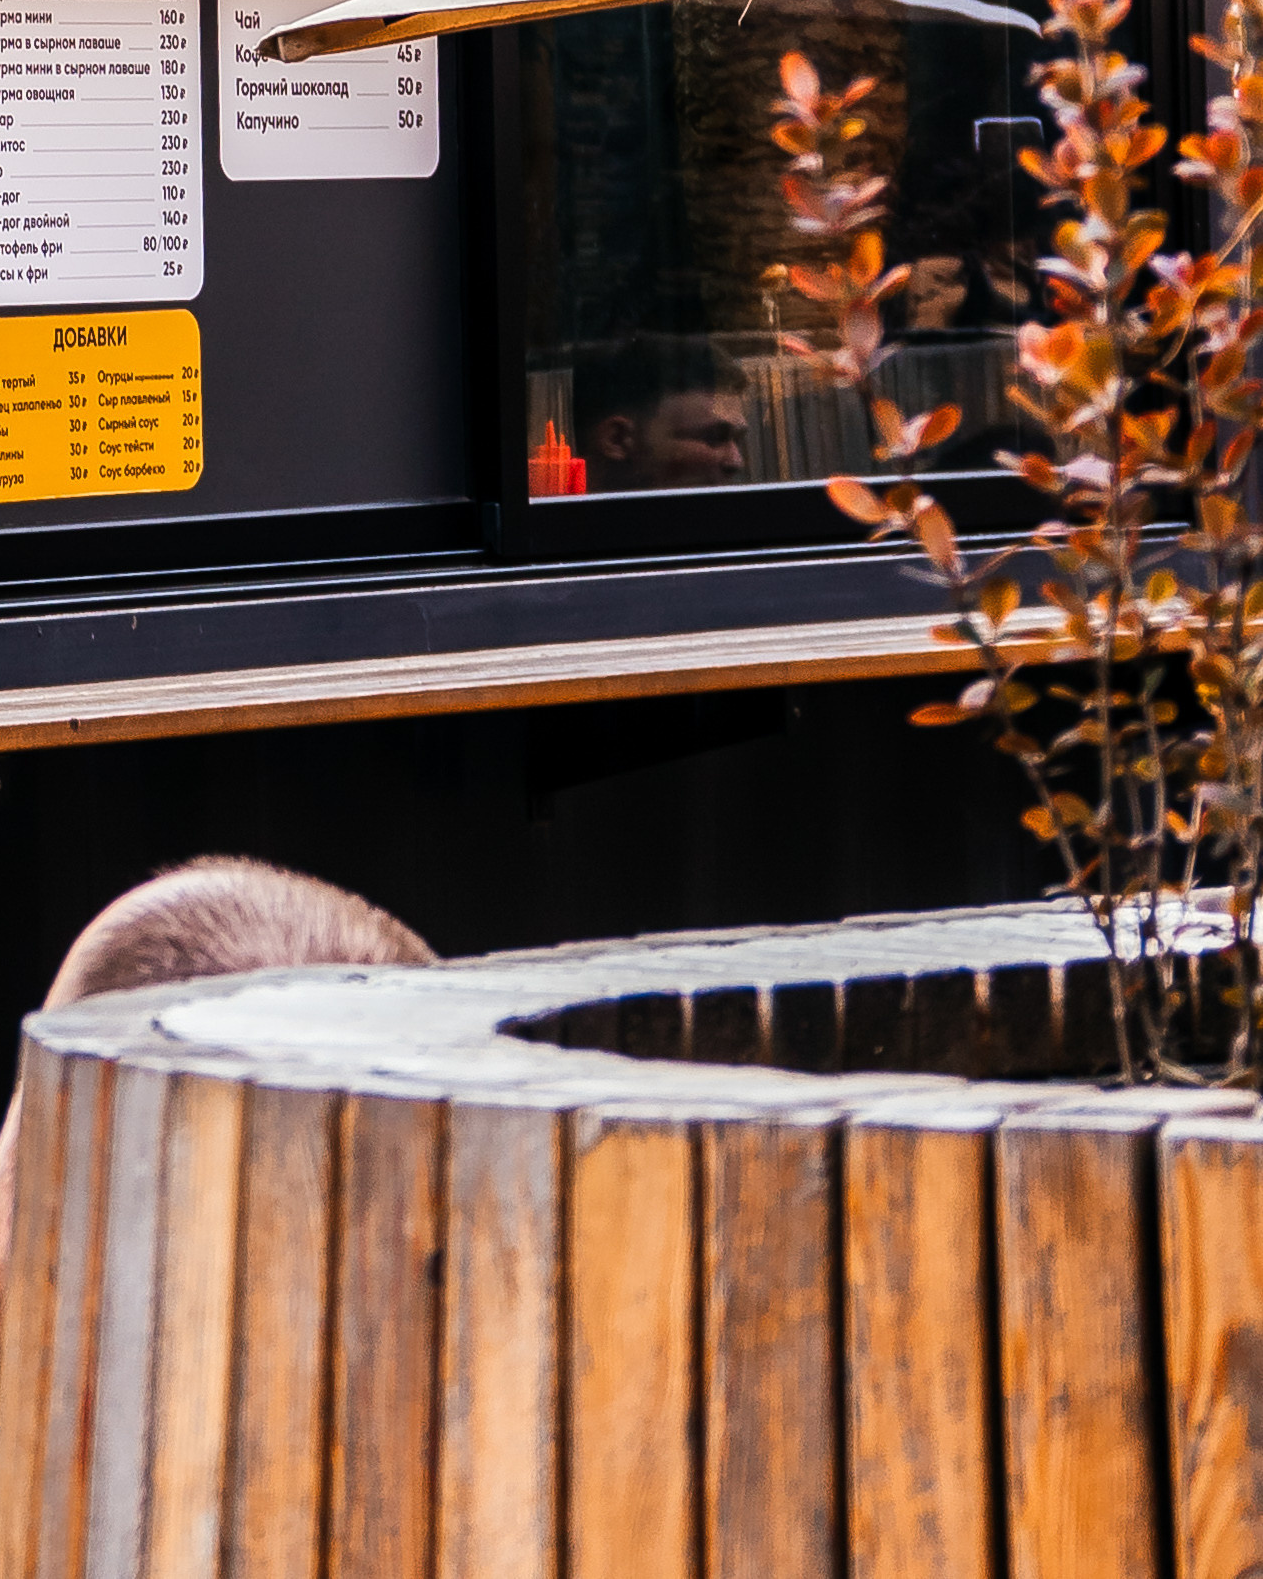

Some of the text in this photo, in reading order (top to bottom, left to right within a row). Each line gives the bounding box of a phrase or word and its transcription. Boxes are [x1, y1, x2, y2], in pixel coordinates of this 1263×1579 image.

[25, 12, 53, 24] мини
[235, 10, 261, 30] Чай
[25, 38, 31, 49] в
[34, 37, 76, 53] сырном
[78, 37, 121, 49] лаваше
[26, 63, 53, 75] мини
[56, 64, 62, 75] в
[64, 63, 106, 79] сырном
[109, 63, 151, 75] лаваше
[26, 88, 75, 103] овощная
[236, 77, 288, 101] Горячий
[291, 81, 349, 99] шоколад
[236, 111, 299, 134] Капучино
[23, 213, 70, 231] двойной
[41, 239, 63, 258] фри
[18, 268, 24, 280] к
[26, 265, 48, 283] фри
[53, 325, 127, 352] ДОБАВКИ
[2, 374, 35, 390] тертый
[98, 370, 134, 386] Огурцы
[12, 399, 62, 412] халапеньо
[98, 393, 118, 409] Сыр
[120, 391, 171, 406] плавленый
[98, 416, 136, 433] Сырный
[139, 418, 159, 431] соус
[99, 441, 122, 457] Соус
[124, 440, 154, 452] тейсти
[99, 464, 122, 481] Соус
[124, 463, 165, 478] барбекю
